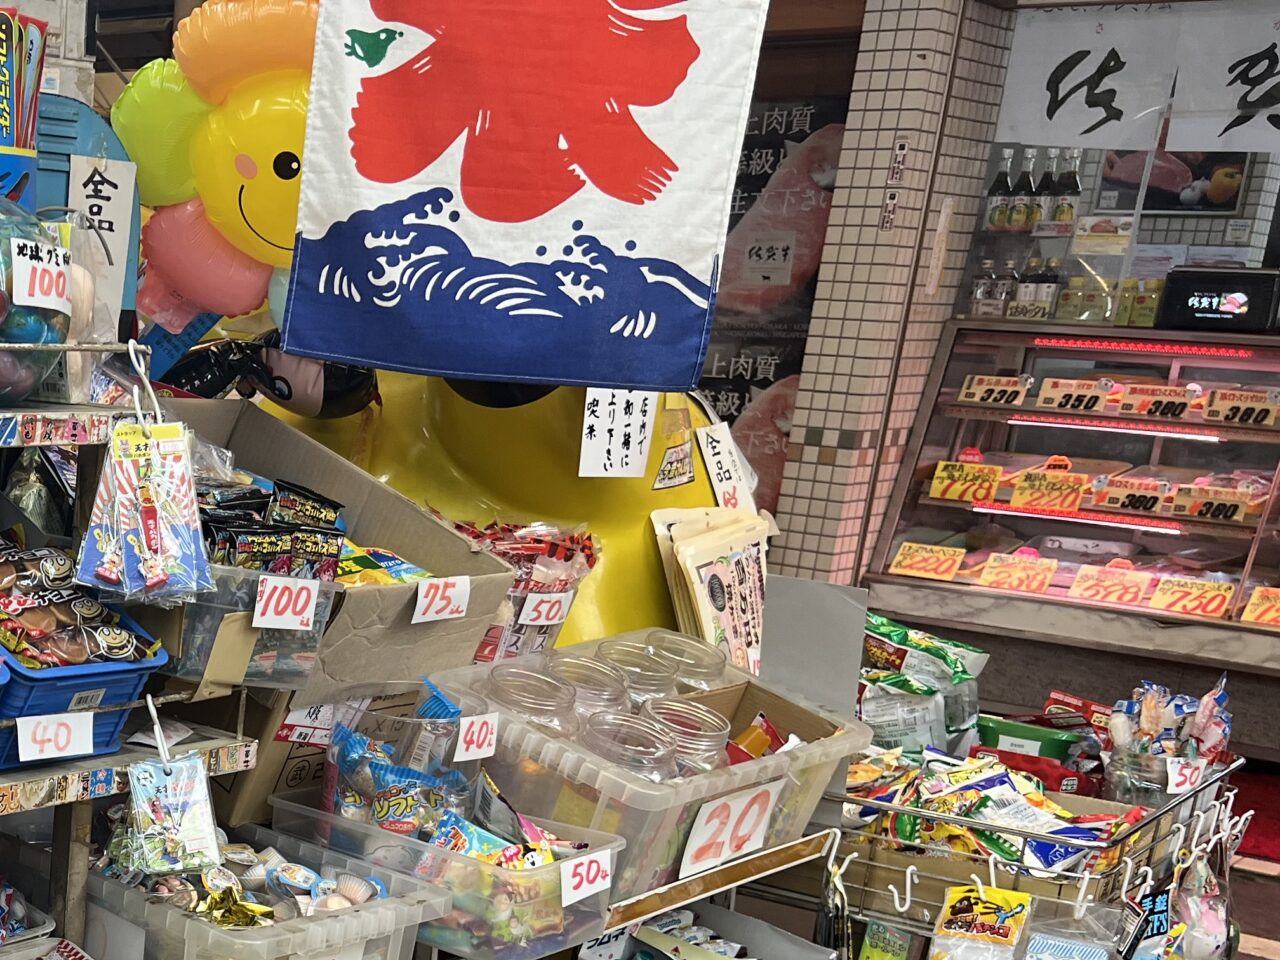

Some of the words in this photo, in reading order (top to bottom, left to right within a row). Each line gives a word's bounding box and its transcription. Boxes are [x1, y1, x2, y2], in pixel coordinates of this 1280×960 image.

[82, 166, 119, 233] 全品
[1057, 393, 1101, 410] 350
[1165, 590, 1227, 616] 750
[29, 719, 72, 755] 40
[689, 788, 772, 863] 20
